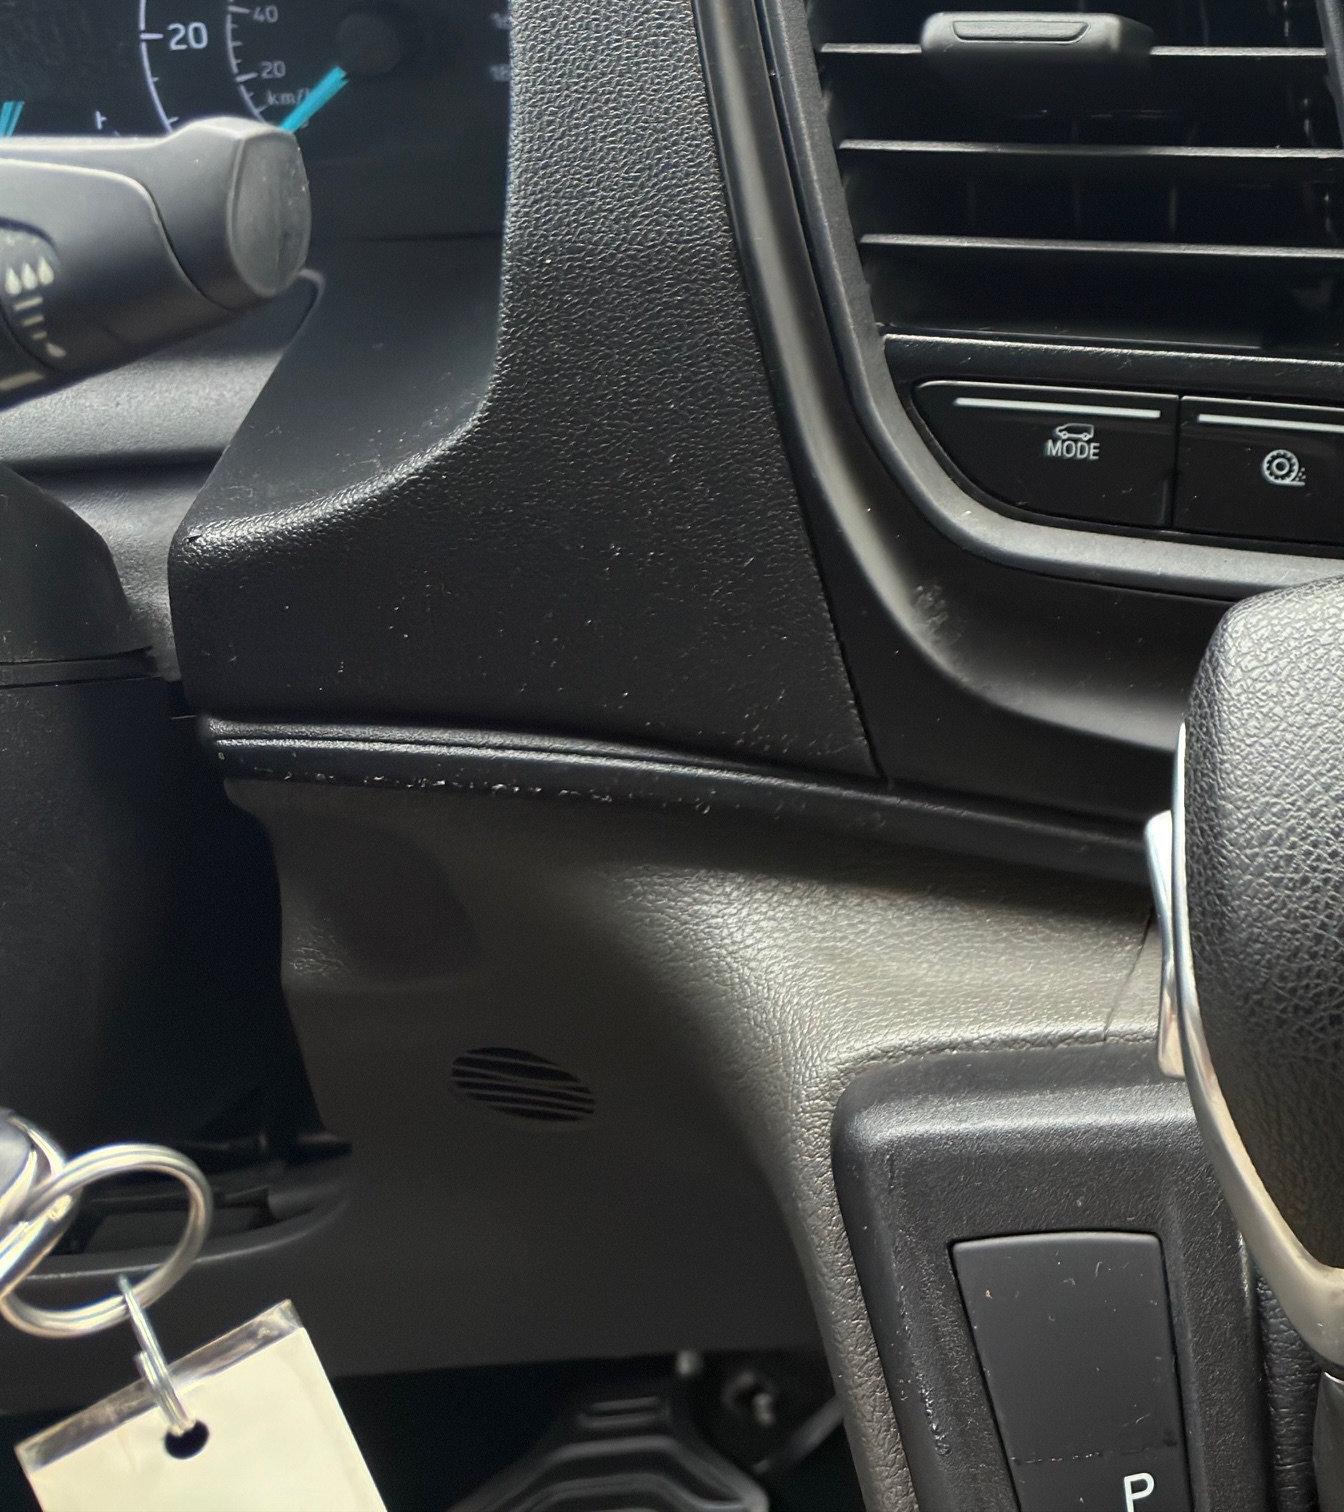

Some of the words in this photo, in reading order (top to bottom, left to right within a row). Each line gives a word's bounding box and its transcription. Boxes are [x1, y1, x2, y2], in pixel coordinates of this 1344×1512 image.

[252, 5, 279, 23] 40
[167, 20, 209, 52] 20
[258, 59, 287, 80] 20
[265, 86, 311, 108] km/
[1046, 438, 1101, 460] MODE
[1122, 1471, 1156, 1512] P
